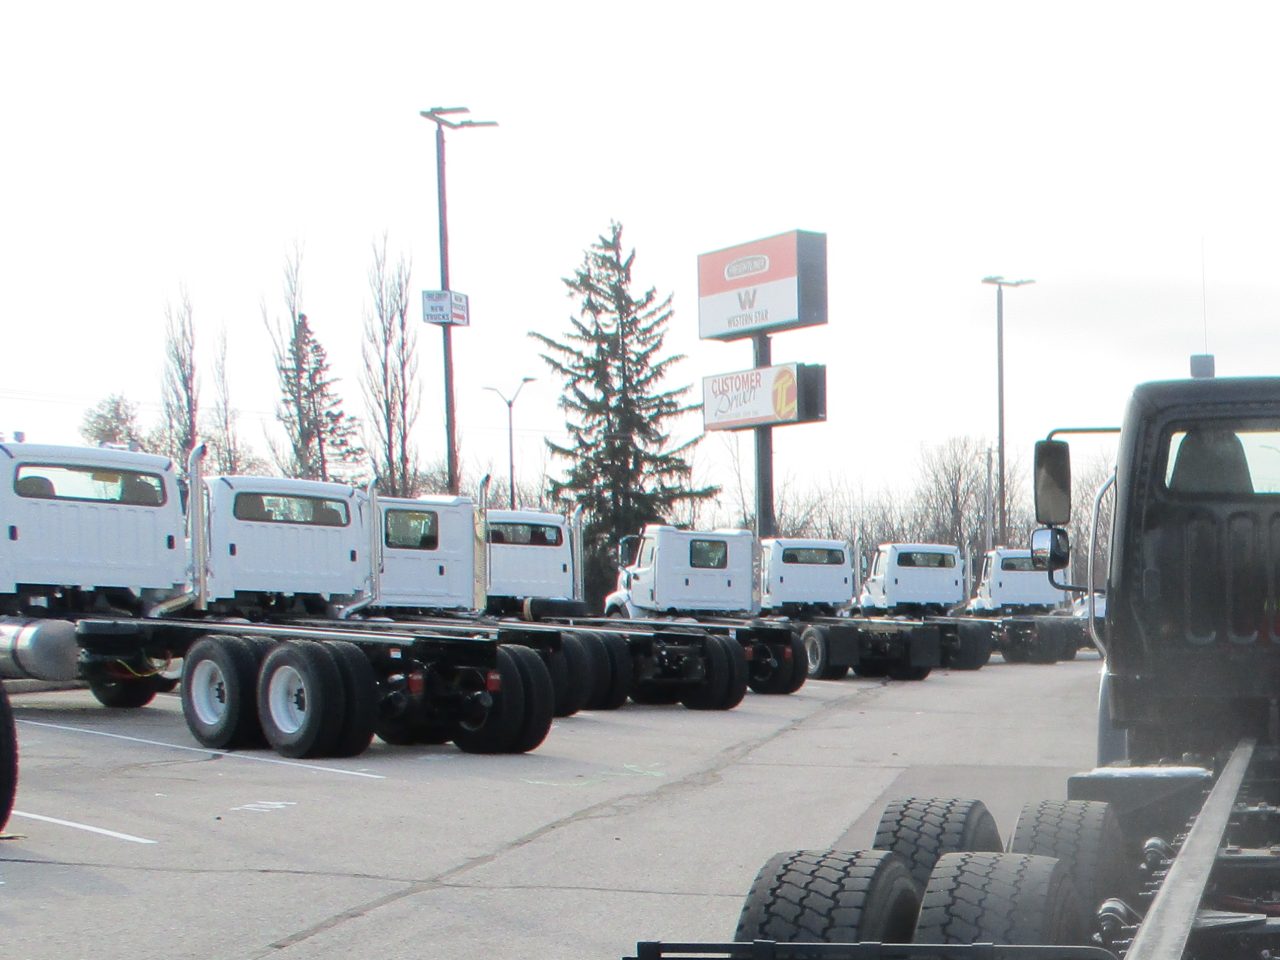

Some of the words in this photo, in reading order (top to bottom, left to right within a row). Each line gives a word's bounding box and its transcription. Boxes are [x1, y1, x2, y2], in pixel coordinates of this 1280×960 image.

[727, 313, 754, 328] WESTERN
[754, 310, 769, 324] STAR
[711, 372, 762, 396] CUSTOMER
